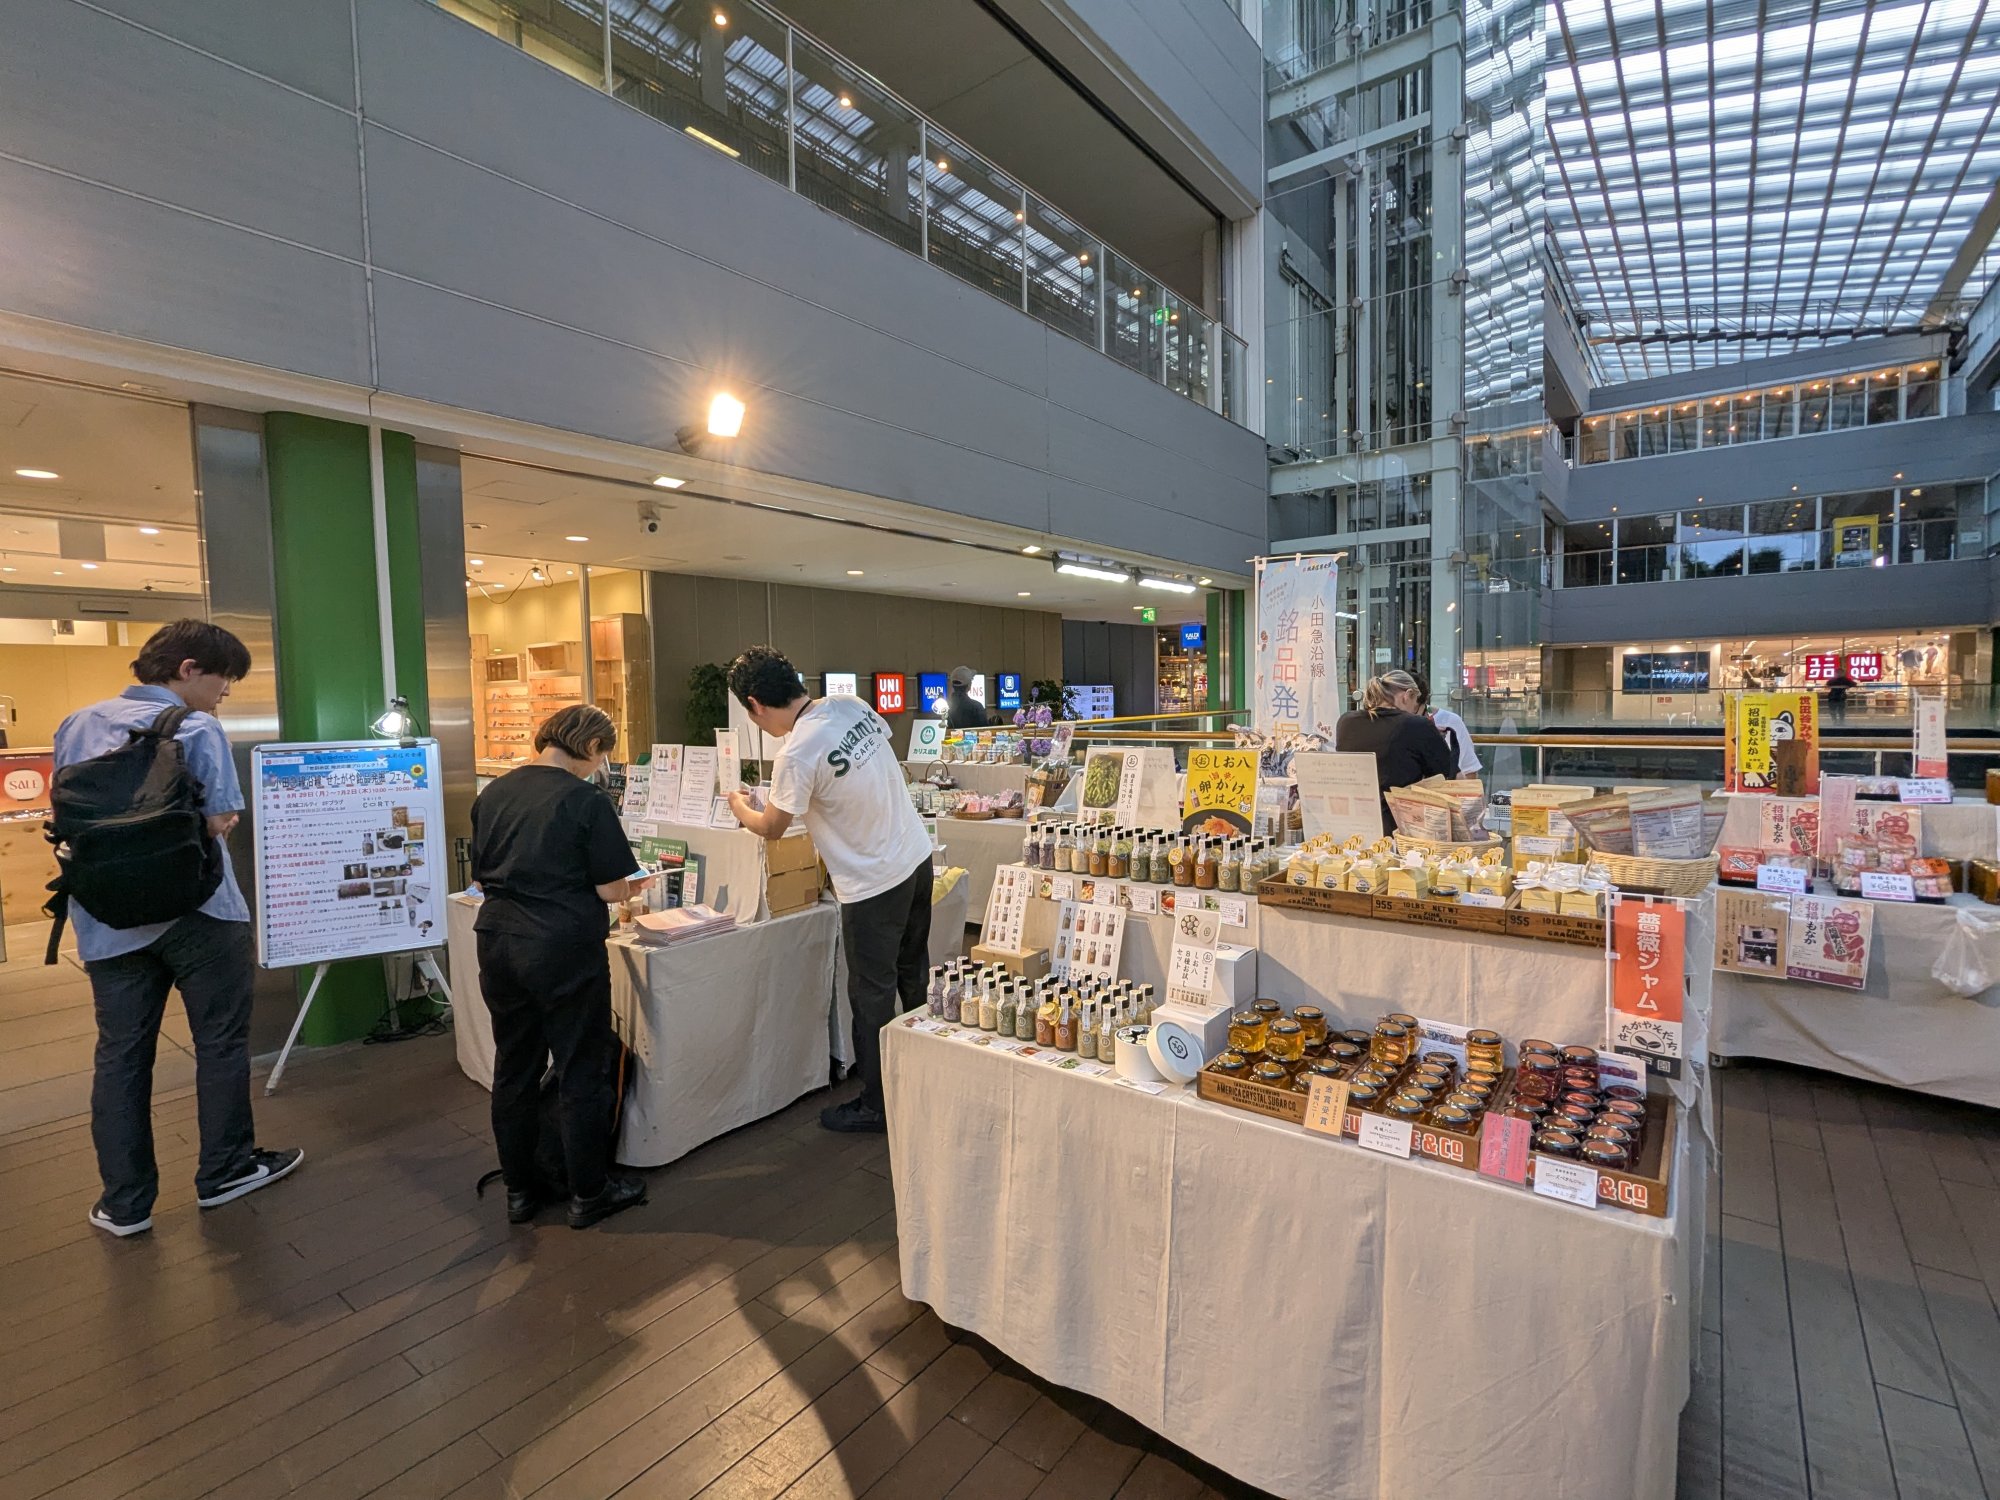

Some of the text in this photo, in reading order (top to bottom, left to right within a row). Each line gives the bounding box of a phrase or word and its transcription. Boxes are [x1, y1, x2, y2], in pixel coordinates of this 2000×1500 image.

[1310, 594, 1326, 678] 小田急沿線
[1850, 656, 1877, 666] UNI
[1850, 667, 1878, 678] QLO
[829, 683, 853, 693] 三省堂
[879, 679, 899, 693] UNI
[880, 694, 902, 710] QLO
[1747, 707, 1760, 756] 招福もなか
[827, 710, 883, 778] Swami's
[854, 737, 875, 761] CAFE
[1213, 755, 1253, 769] しお八
[1198, 778, 1246, 795] 卵かけ
[362, 800, 396, 808] CORTY
[1202, 793, 1237, 808] ごはん
[1771, 804, 1785, 844] 招福もなか
[1260, 885, 1275, 896] 955
[1375, 899, 1393, 910] 955
[1510, 915, 1530, 926] 955
[1804, 900, 1819, 945] 招福もなか
[1181, 950, 1191, 988] 8種お試し
[1191, 951, 1199, 976] しお八
[1636, 912, 1662, 1012] 薔薇ジャム
[1617, 1020, 1678, 1052] せたがやそだち
[1241, 1088, 1268, 1105] CRYSTAL
[1268, 1095, 1288, 1109] SUGAR
